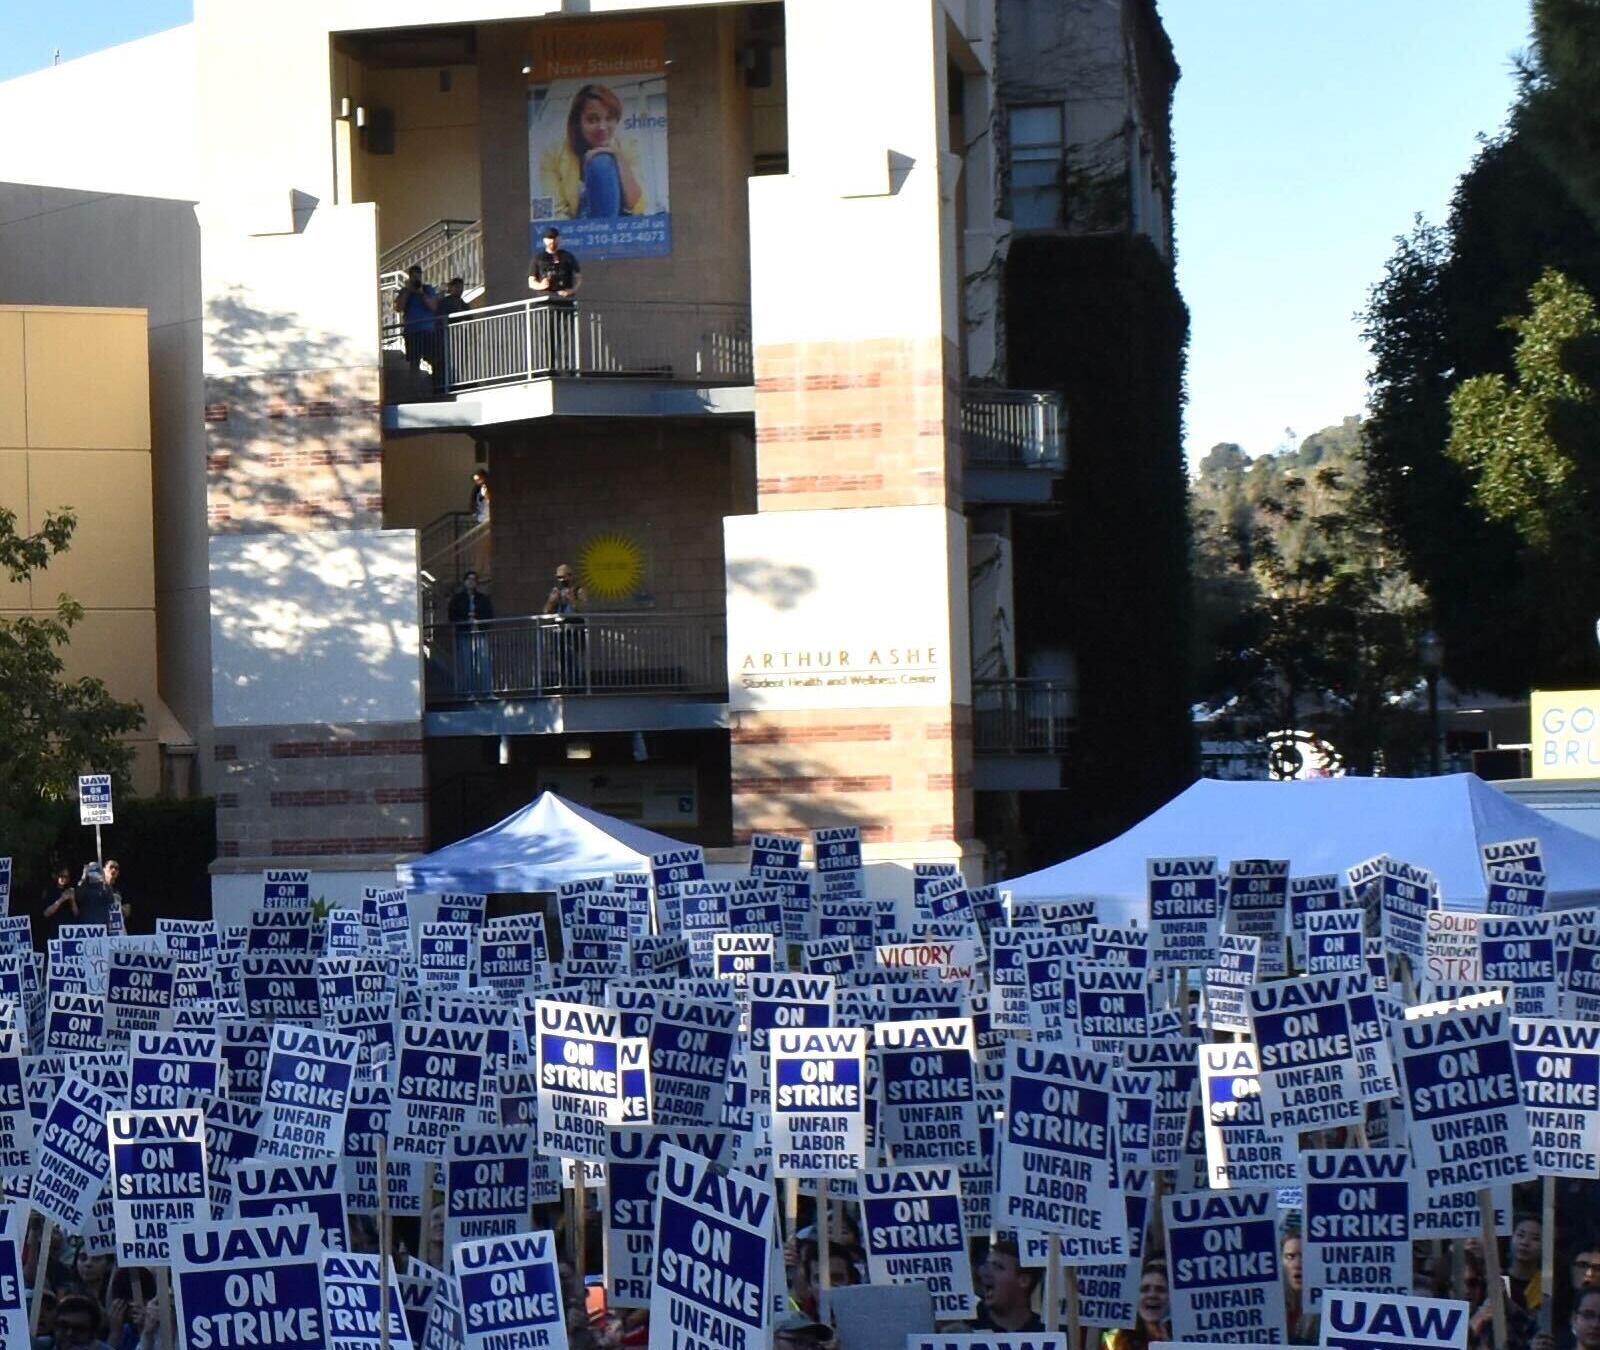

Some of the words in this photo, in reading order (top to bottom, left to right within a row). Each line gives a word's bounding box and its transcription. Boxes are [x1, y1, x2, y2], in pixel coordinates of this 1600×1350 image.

[623, 112, 666, 130] shine
[742, 650, 850, 669] ARTHUR
[869, 648, 937, 665] ASHE
[743, 677, 785, 689] Student
[827, 676, 847, 686] and
[850, 674, 896, 685] Wellness
[1153, 860, 1215, 877] UAW
[1170, 881, 1196, 897] ON
[1153, 897, 1215, 915] STRIKE
[1160, 920, 1207, 934] UNFAIR
[1163, 935, 1205, 948] LABOR
[1426, 932, 1458, 944] WITH
[879, 945, 954, 969] VICTORY
[1154, 948, 1215, 961] PRACTICE
[937, 966, 972, 980] UAW
[779, 1034, 858, 1054] UAW
[801, 1060, 834, 1082] ON
[779, 1083, 858, 1106] STRIKE
[788, 1116, 847, 1133] UNFAIR
[791, 1134, 844, 1151] LABOR
[779, 1153, 859, 1169] PRACTICE
